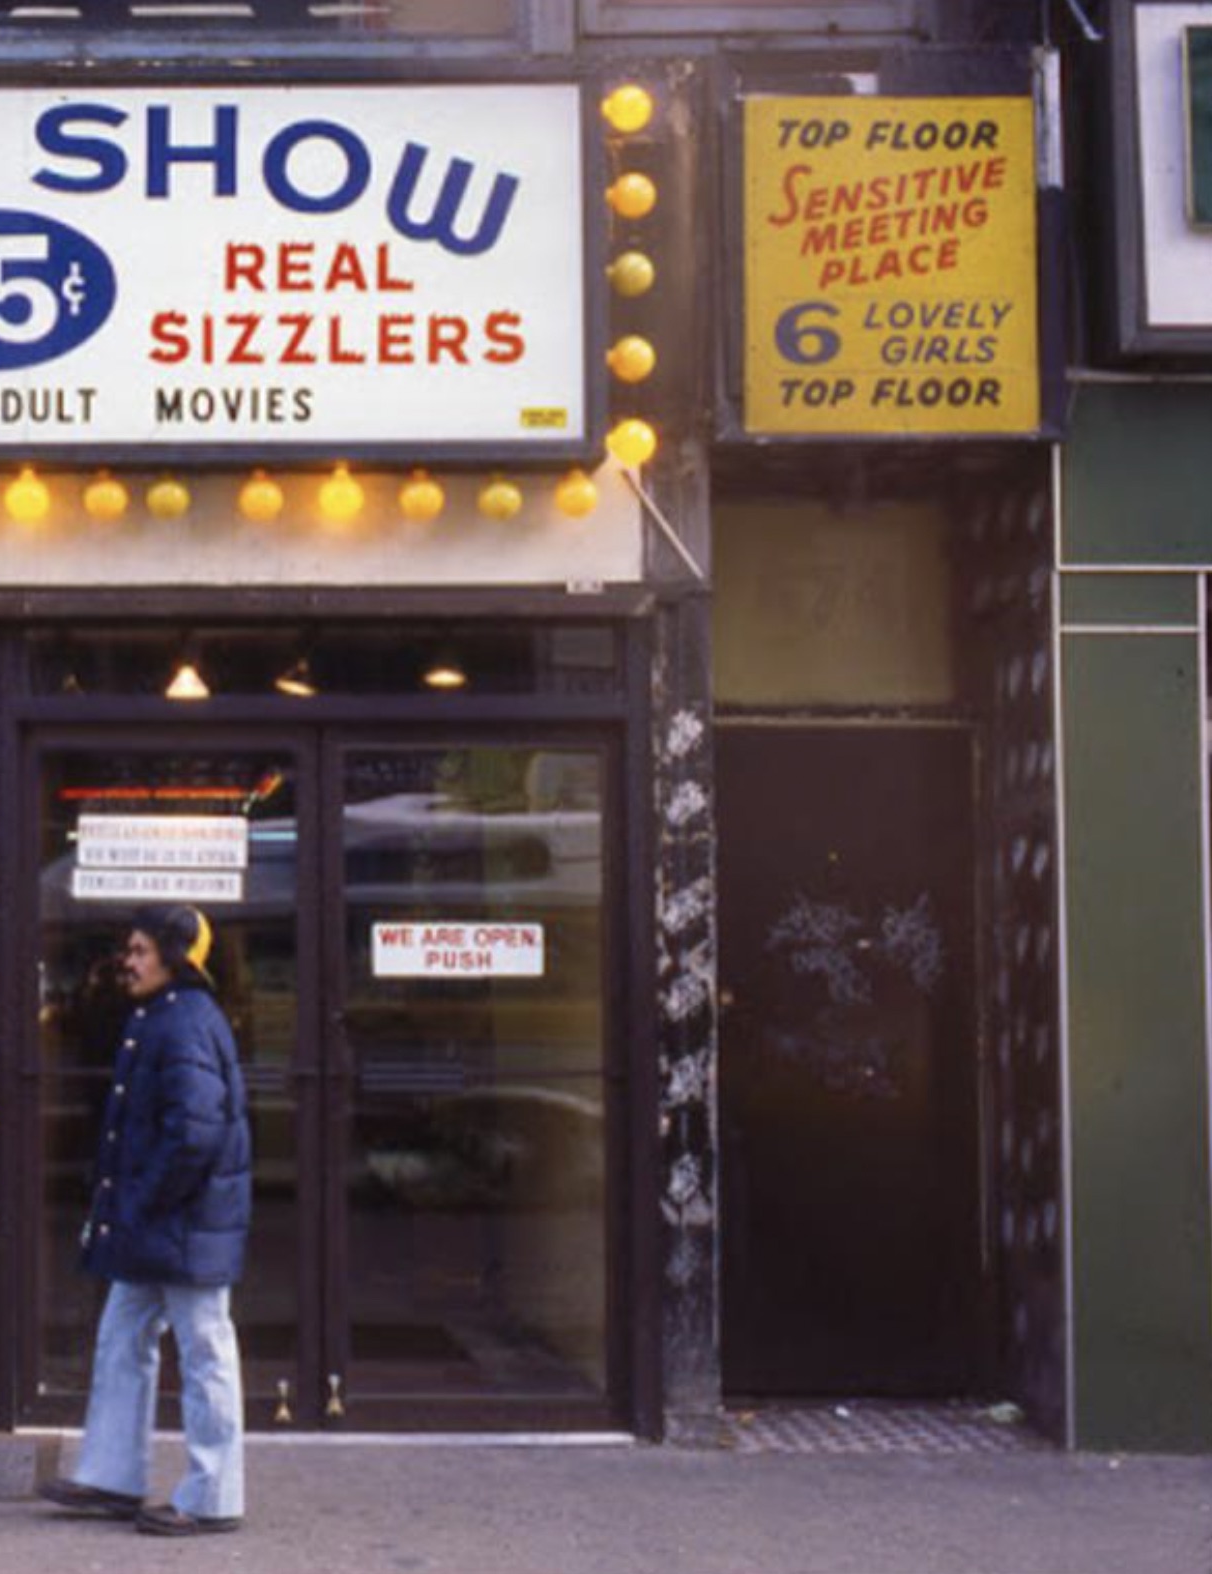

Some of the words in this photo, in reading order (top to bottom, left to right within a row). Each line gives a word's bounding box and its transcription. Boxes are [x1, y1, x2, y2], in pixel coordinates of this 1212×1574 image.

[778, 119, 851, 149] TOP
[865, 119, 999, 150] FLOOR
[31, 102, 519, 256] SHOW
[767, 156, 1007, 226] SENSITIVE
[800, 197, 988, 257] MEETING
[223, 242, 414, 292] REAL
[818, 237, 960, 290] PLACE
[149, 310, 525, 365] SIZZLERS
[773, 301, 842, 366] 6
[863, 301, 1013, 330] LOVELY
[880, 334, 999, 365] GIRLS
[155, 387, 314, 424] MOVIES
[779, 378, 856, 408] TOP
[871, 375, 1002, 408] FLOOR
[378, 928, 414, 947] WE
[421, 928, 466, 947] ARE
[425, 951, 492, 970] PUSH
